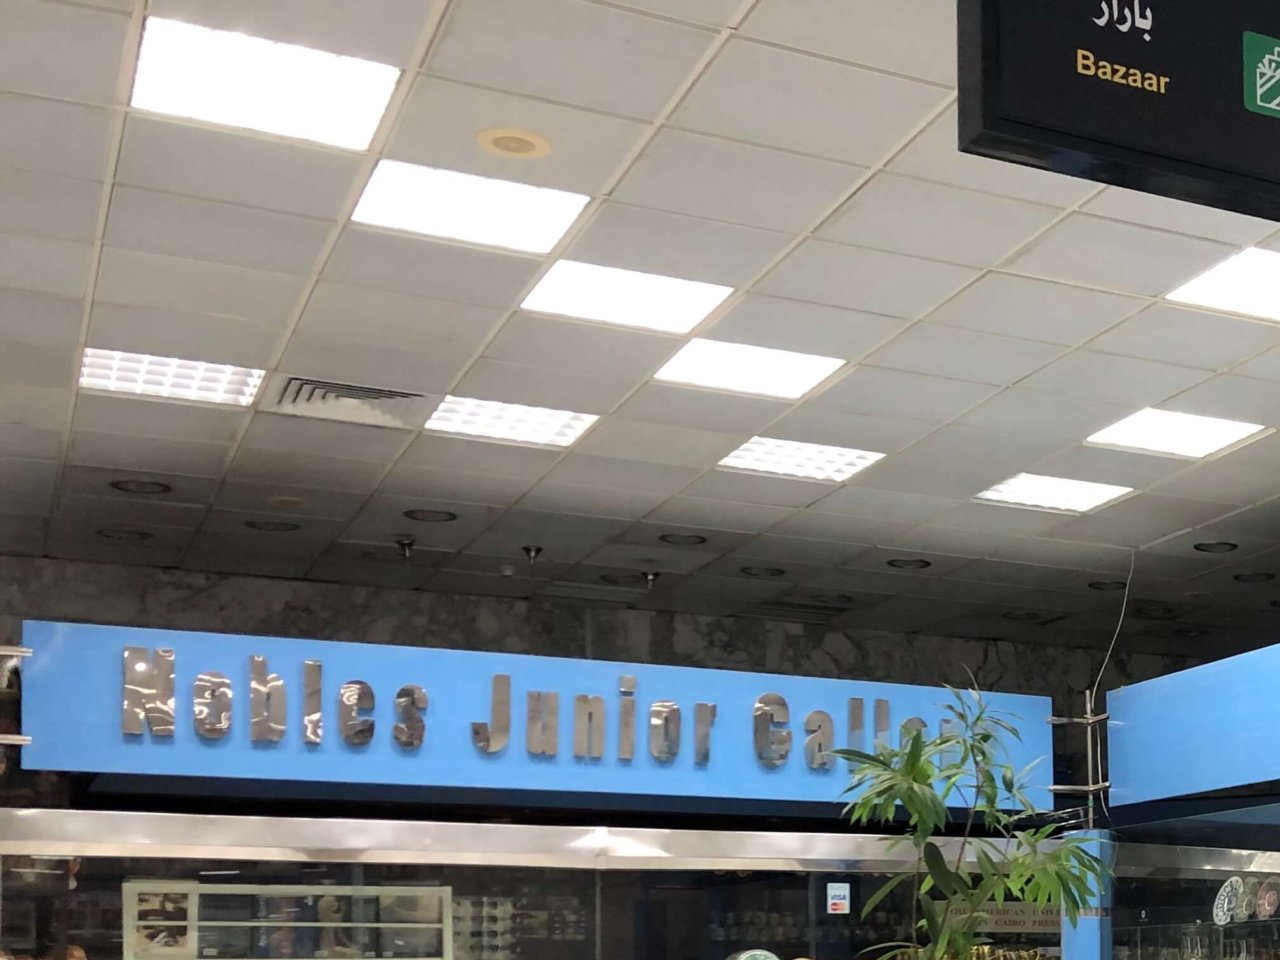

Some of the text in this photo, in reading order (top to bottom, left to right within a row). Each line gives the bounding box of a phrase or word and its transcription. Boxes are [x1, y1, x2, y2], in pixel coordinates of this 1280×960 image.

[1076, 48, 1170, 95] Bazaar
[122, 647, 428, 750] Nobles
[471, 674, 717, 766] Junior
[994, 919, 1026, 928] CAIRO
